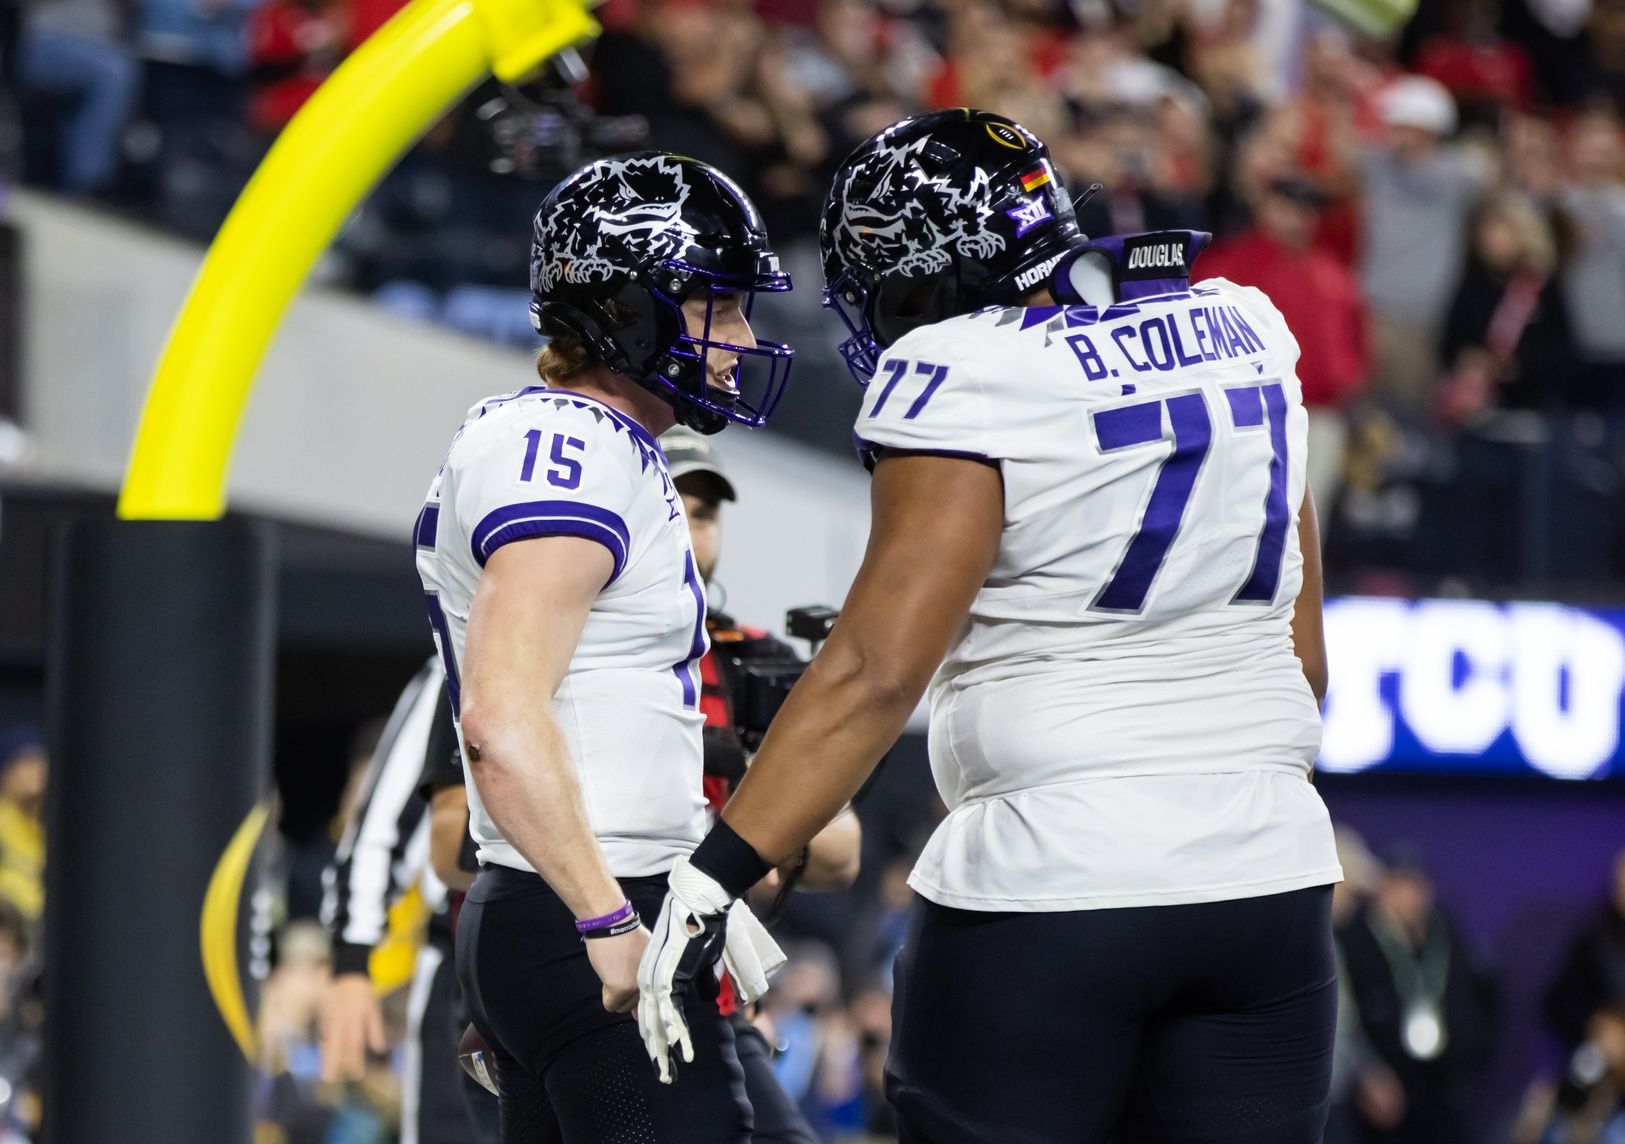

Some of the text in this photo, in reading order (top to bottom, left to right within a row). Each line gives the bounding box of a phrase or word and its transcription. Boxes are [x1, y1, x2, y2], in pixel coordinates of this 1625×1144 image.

[1013, 249, 1072, 292] HORN
[1128, 242, 1186, 270] DOUGLAS
[1064, 306, 1266, 382] B. COLEMAN
[868, 357, 950, 420] 77
[518, 428, 586, 491] 15
[1084, 378, 1288, 616] 77
[1317, 596, 1625, 780] TCU
